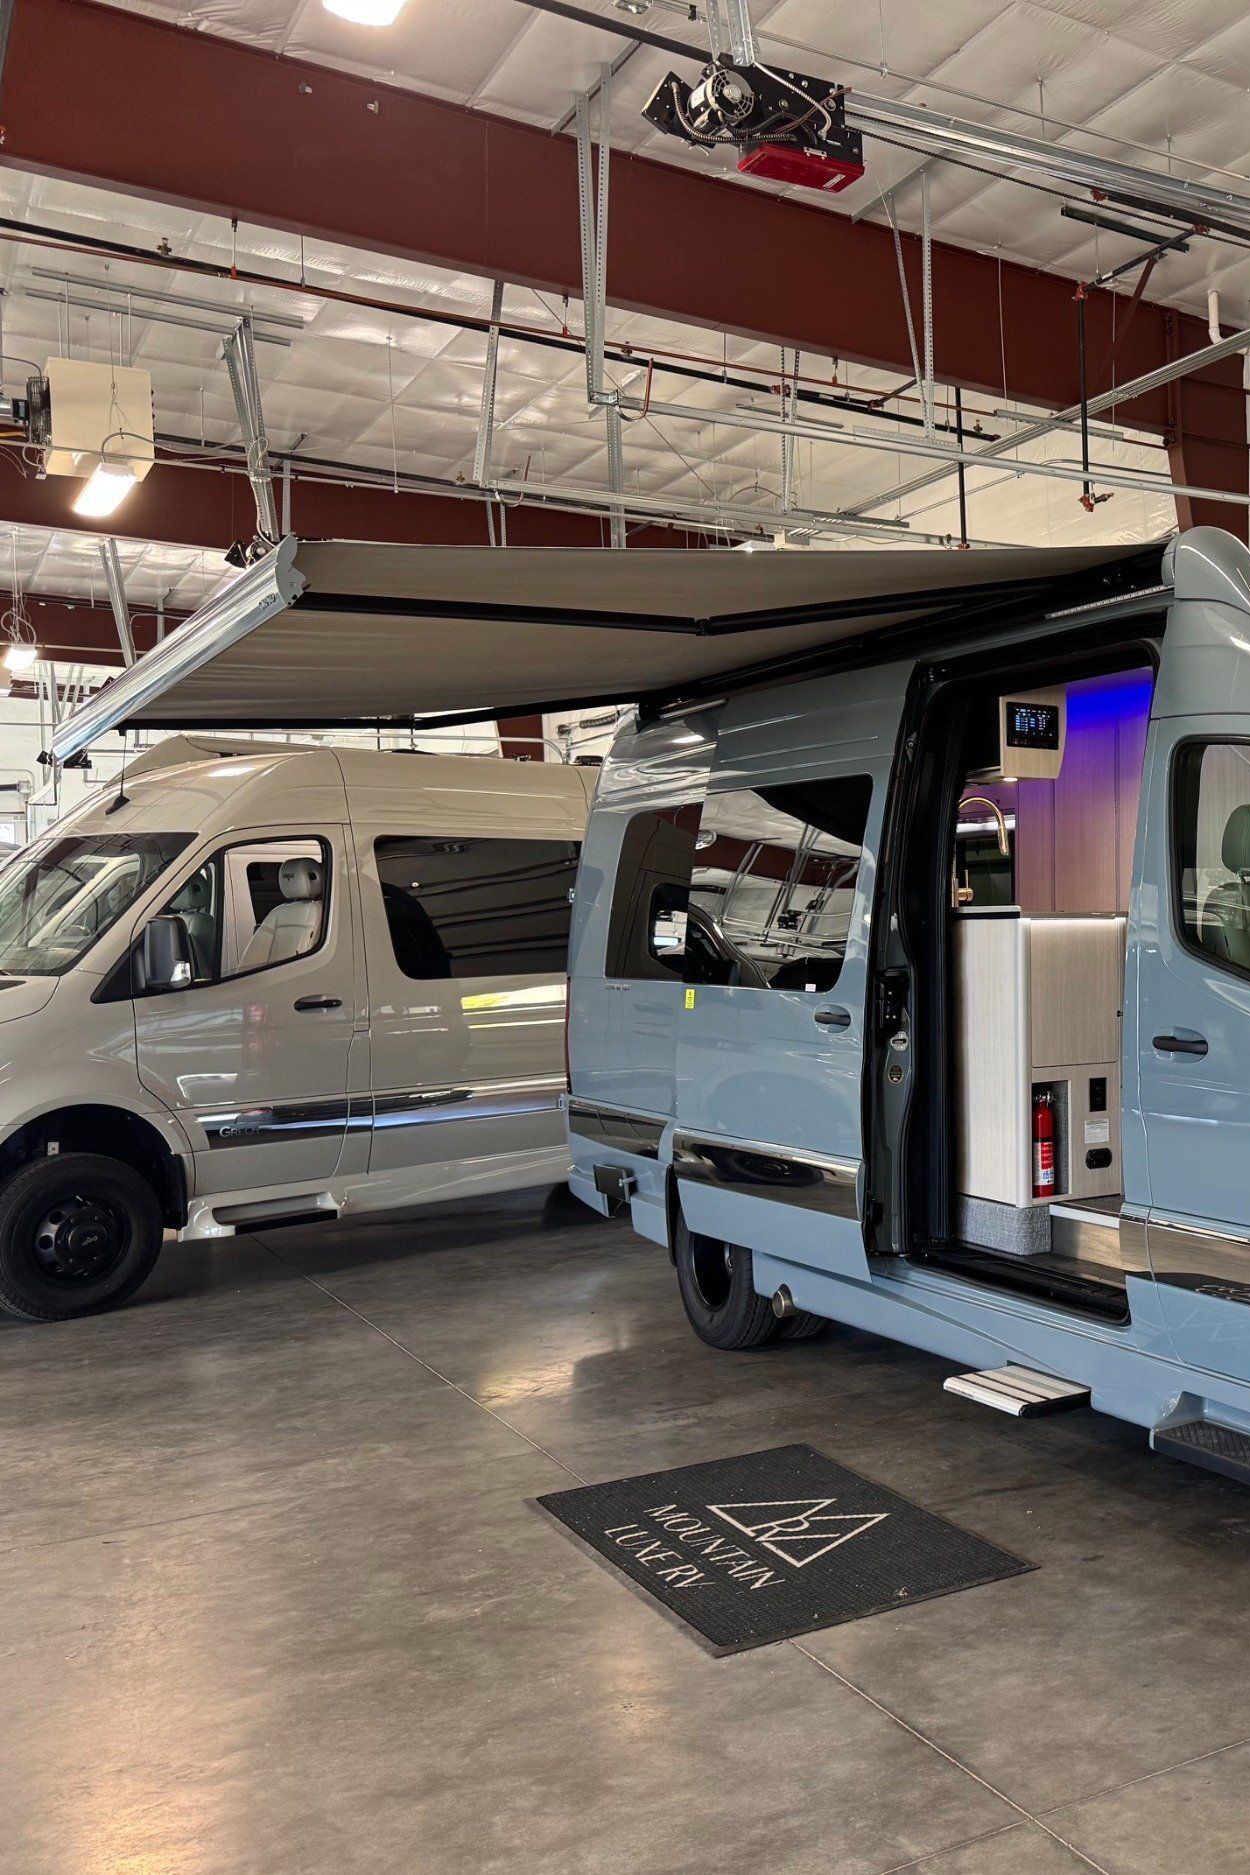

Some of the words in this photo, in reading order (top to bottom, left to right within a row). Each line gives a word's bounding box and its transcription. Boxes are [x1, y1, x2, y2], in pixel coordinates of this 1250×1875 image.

[604, 1524, 683, 1567] LUXE
[656, 1564, 716, 1589] RV
[643, 1503, 786, 1590] MOUNTAIN
